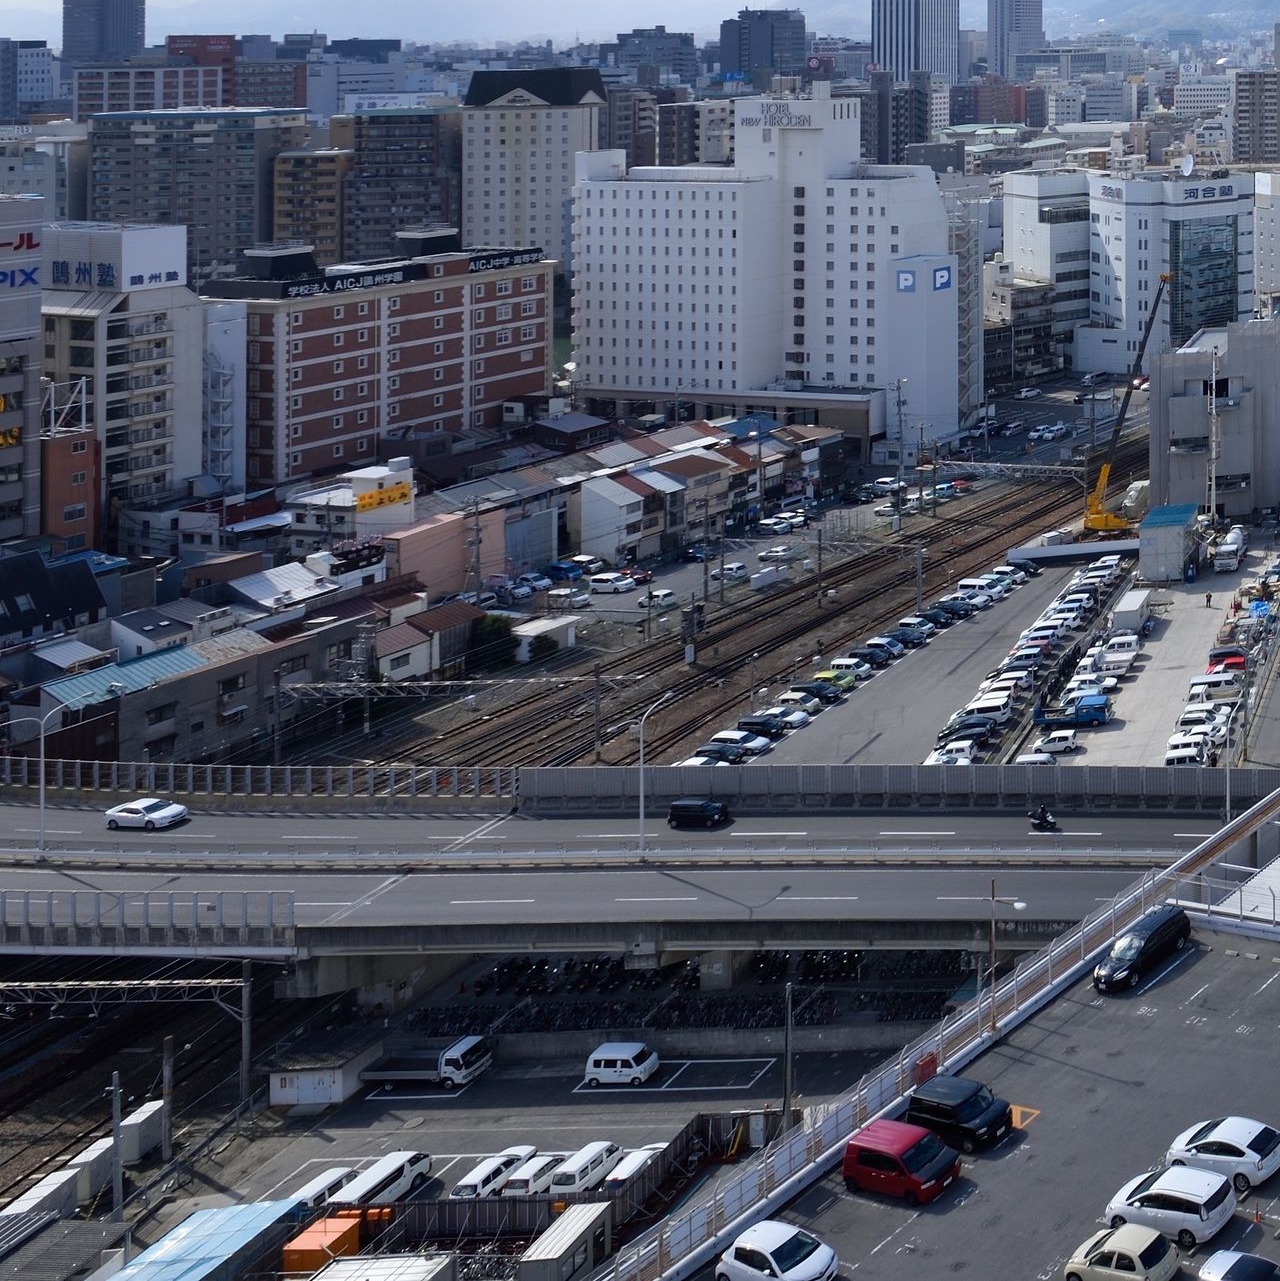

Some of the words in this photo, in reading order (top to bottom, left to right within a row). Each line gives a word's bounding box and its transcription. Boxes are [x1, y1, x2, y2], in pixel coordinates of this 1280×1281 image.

[764, 115, 811, 127] HIRODEN
[14, 126, 33, 135] FLEX
[1184, 185, 1233, 200] 河合塾
[288, 282, 331, 297] 学校法人
